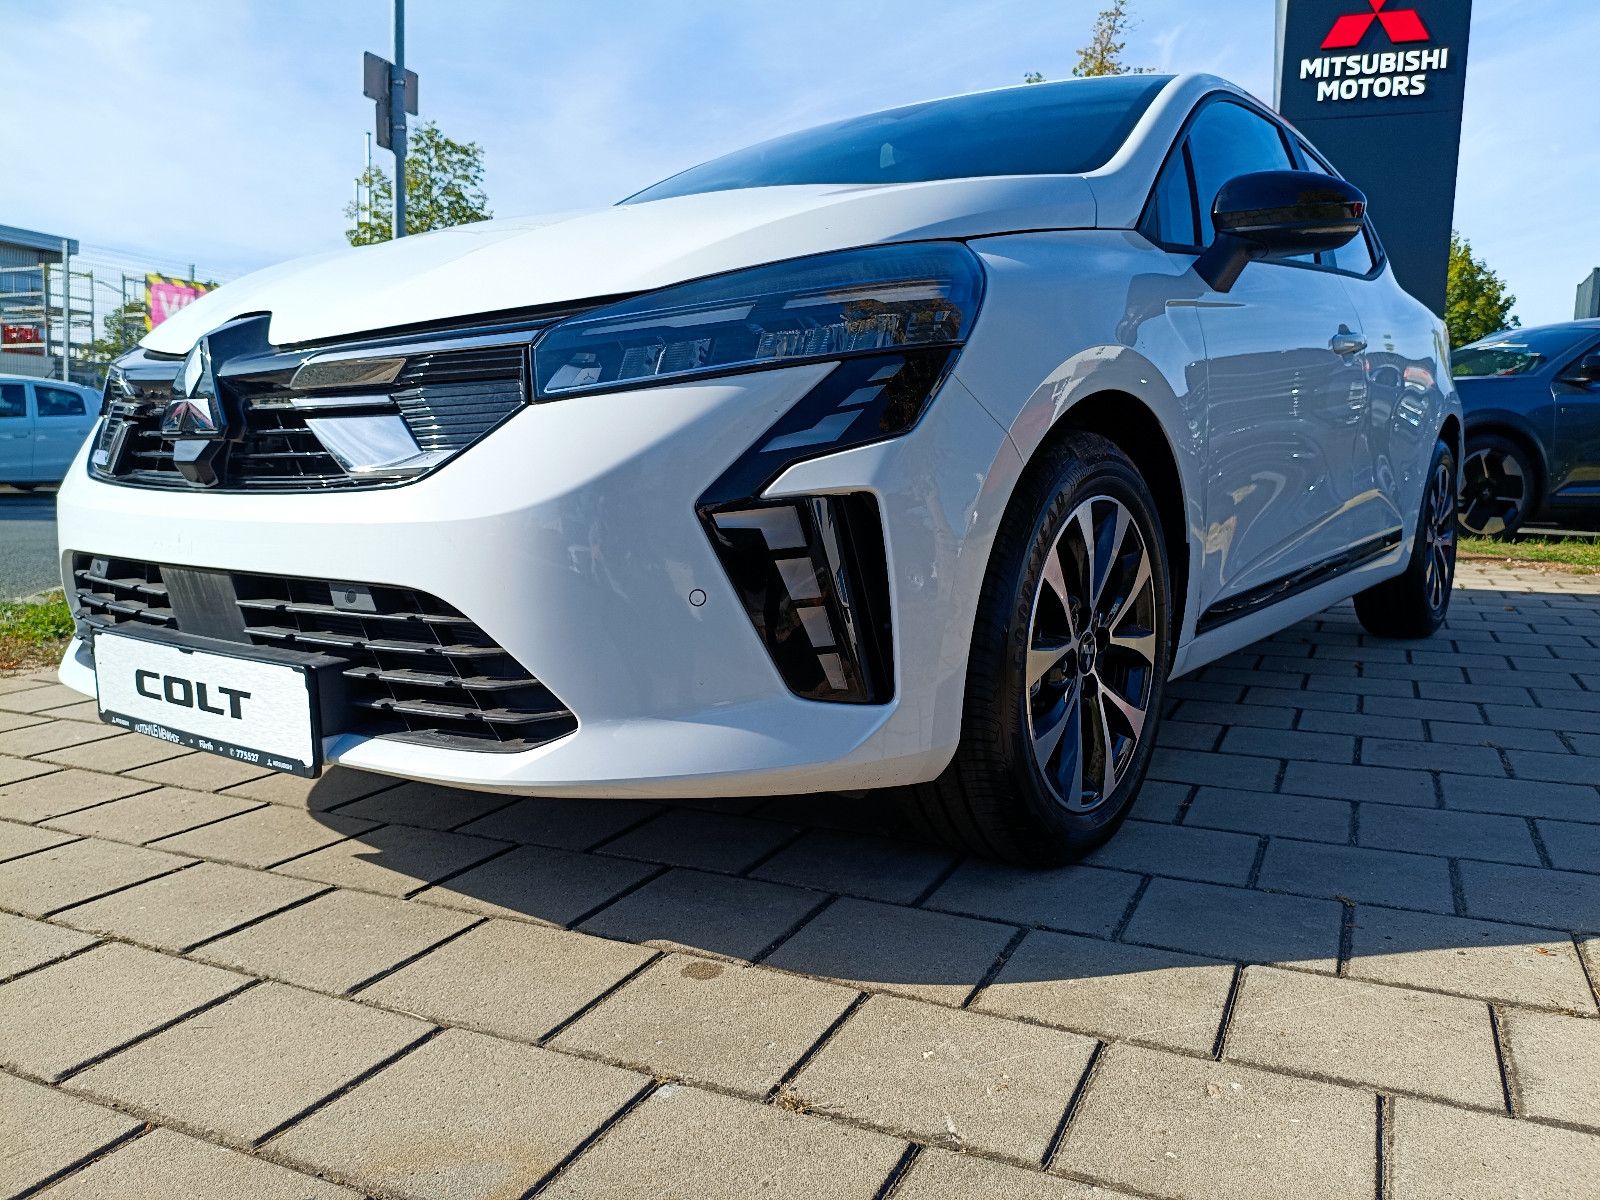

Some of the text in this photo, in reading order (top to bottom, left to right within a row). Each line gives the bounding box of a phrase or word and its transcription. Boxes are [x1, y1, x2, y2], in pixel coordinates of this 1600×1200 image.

[1299, 48, 1449, 80] MITSUBISHI
[1316, 74, 1426, 101] MOTORS
[135, 669, 252, 720] COLT
